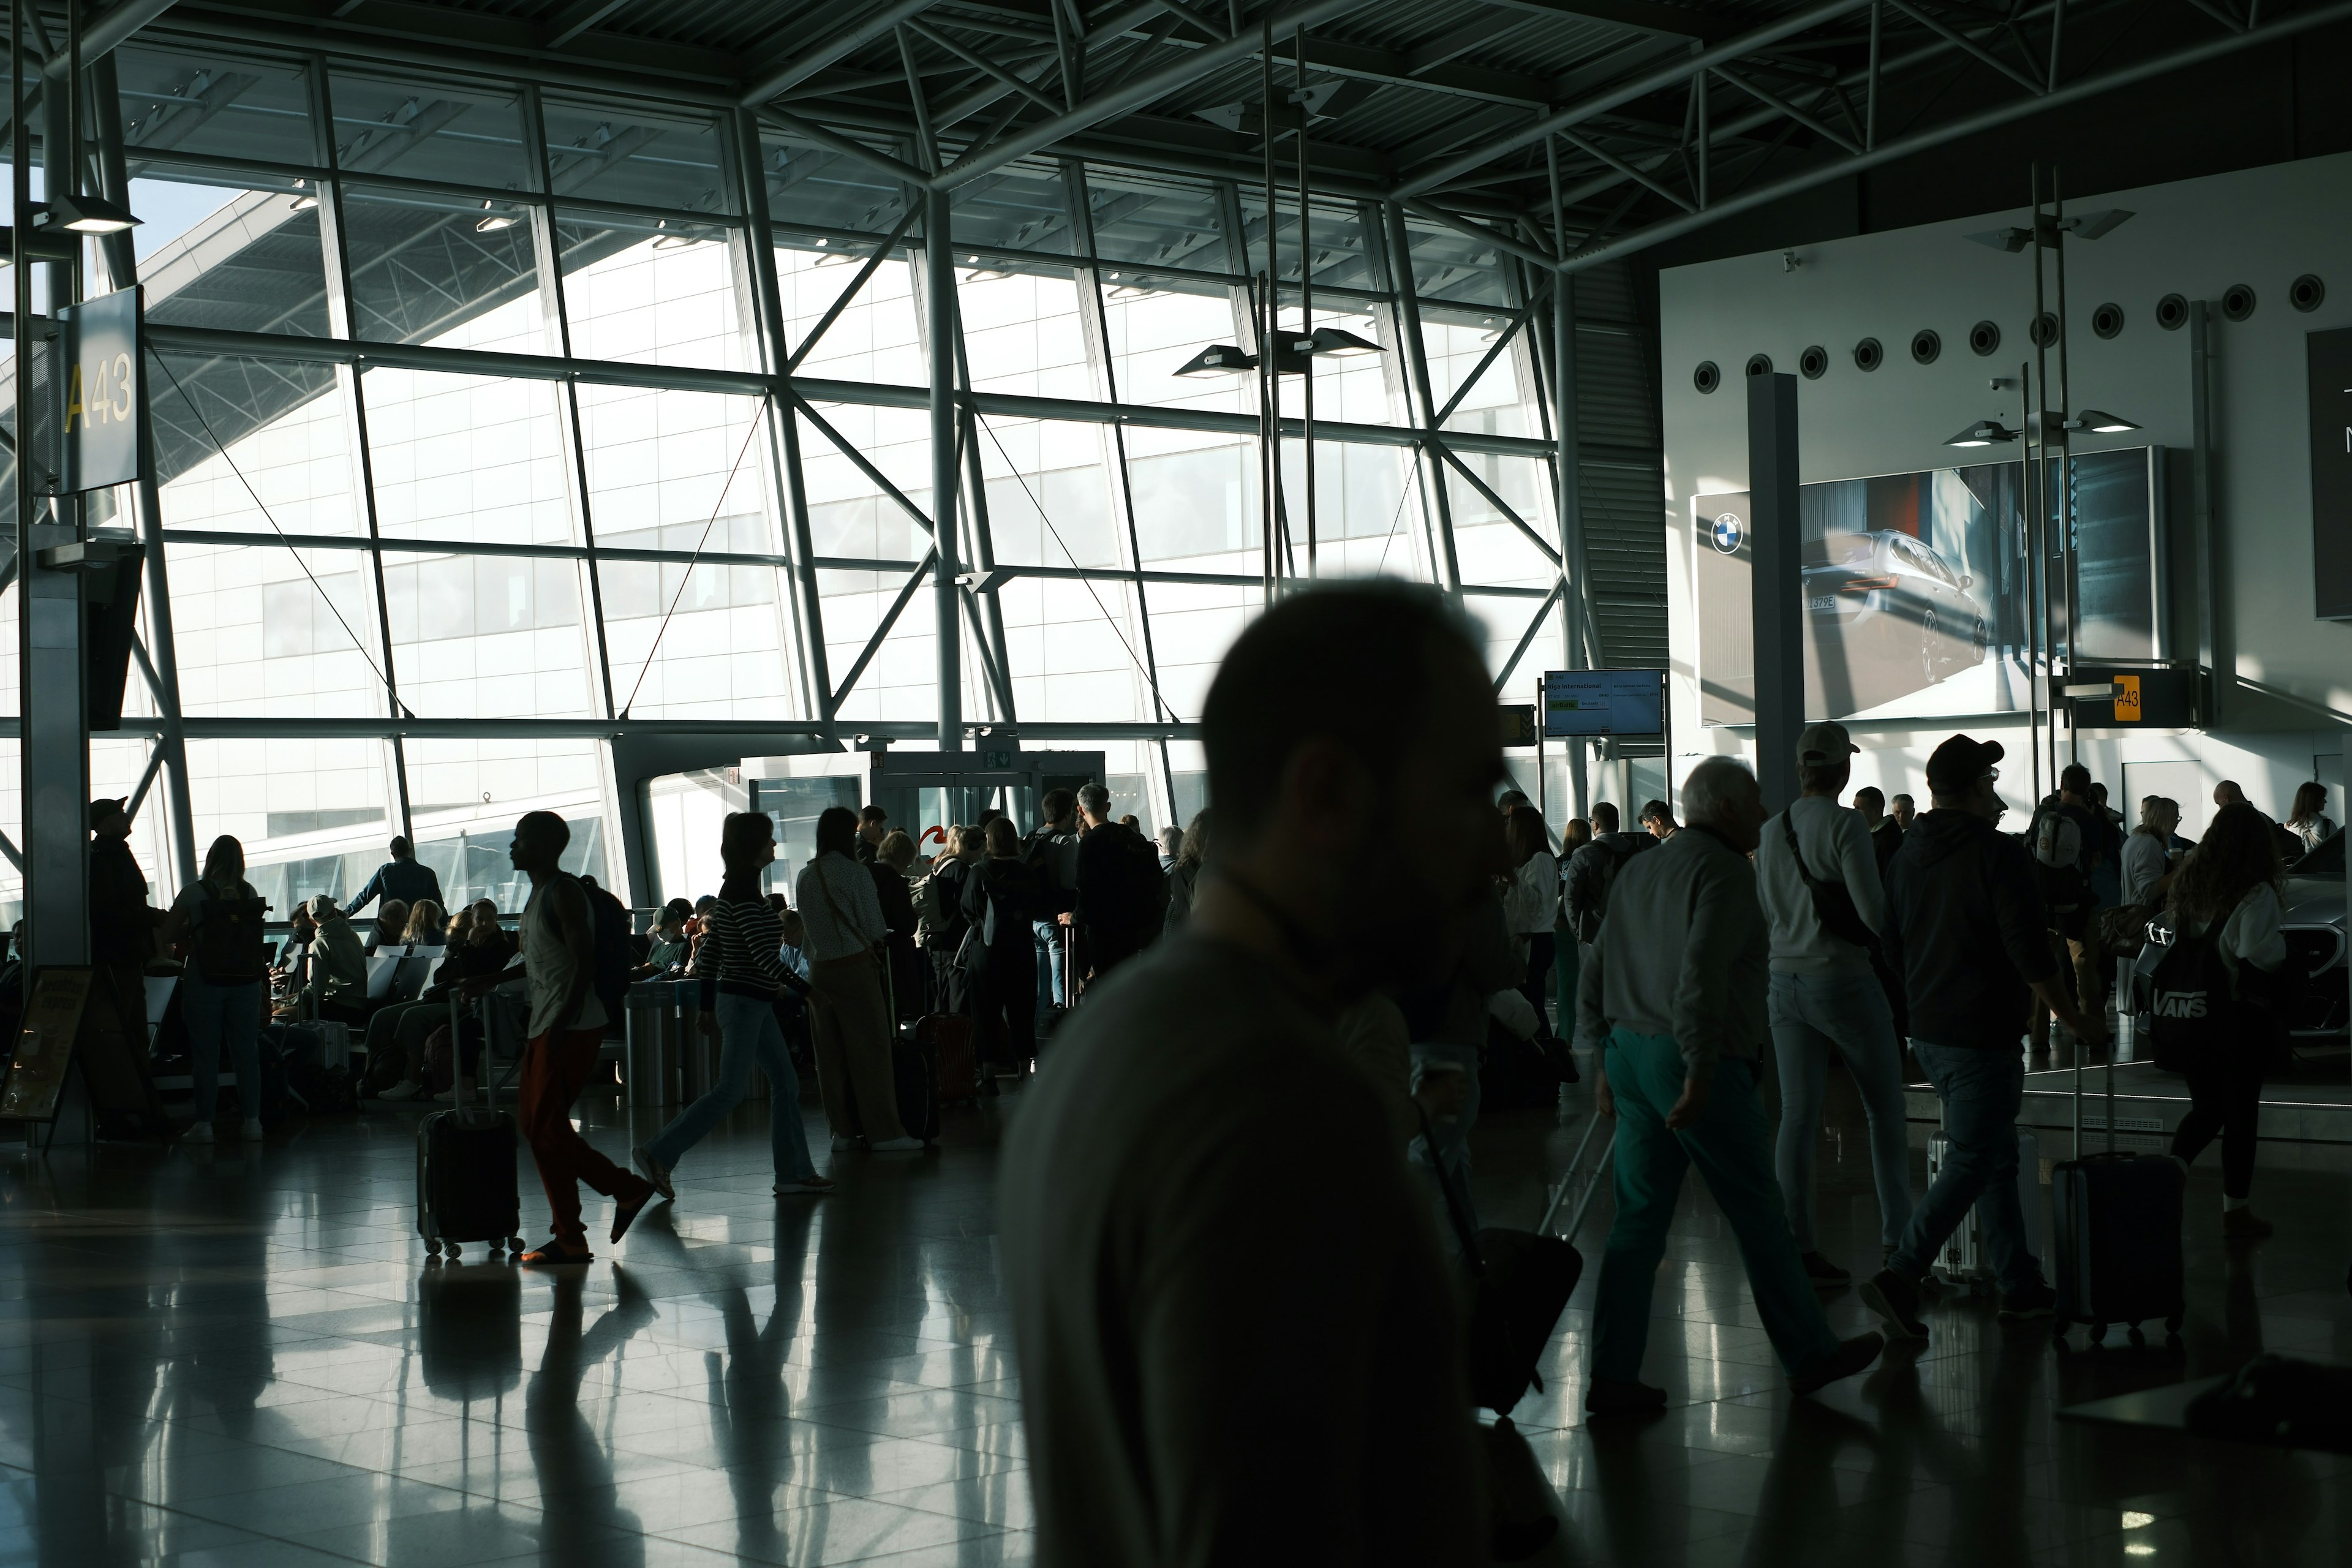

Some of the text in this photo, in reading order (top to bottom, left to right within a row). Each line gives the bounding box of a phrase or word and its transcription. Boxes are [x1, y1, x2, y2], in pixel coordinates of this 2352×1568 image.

[65, 353, 132, 434] A43
[1715, 515, 1739, 528] BMW
[2117, 690, 2138, 707] A43
[40, 995, 78, 1012] express
[2153, 988, 2207, 1019] VANS
